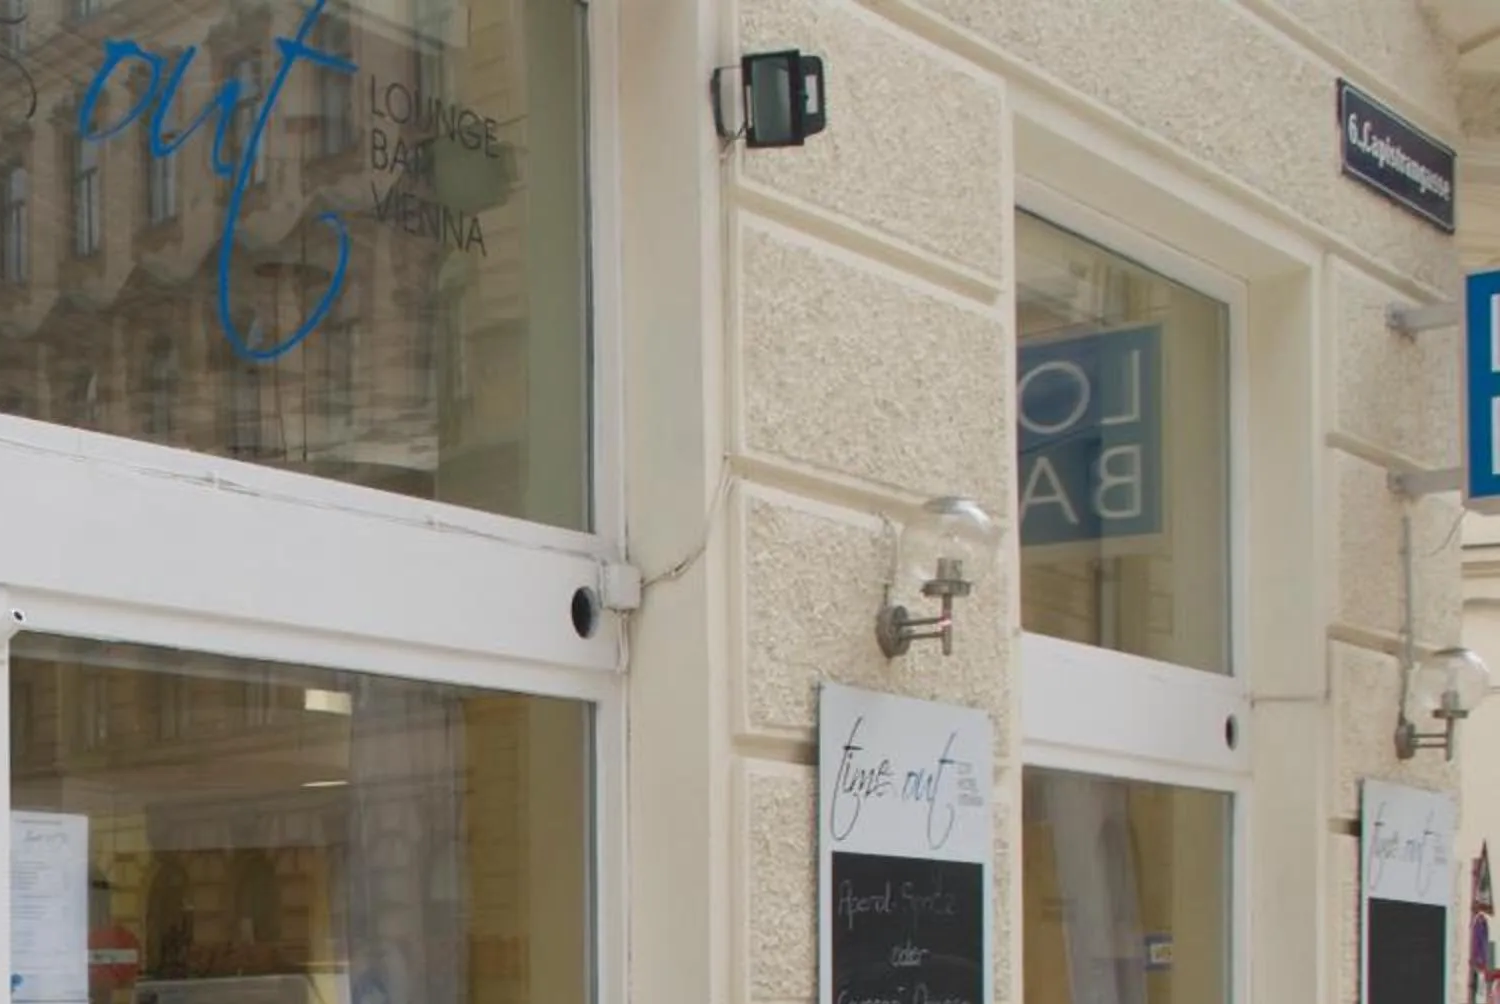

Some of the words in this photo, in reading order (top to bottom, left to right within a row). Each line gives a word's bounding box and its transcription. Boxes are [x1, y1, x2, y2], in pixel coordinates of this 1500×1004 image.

[370, 73, 501, 159] LOUNGE
[78, 0, 358, 361] out
[370, 180, 488, 258] VIENNA
[830, 716, 896, 841] time
[901, 731, 959, 850] out
